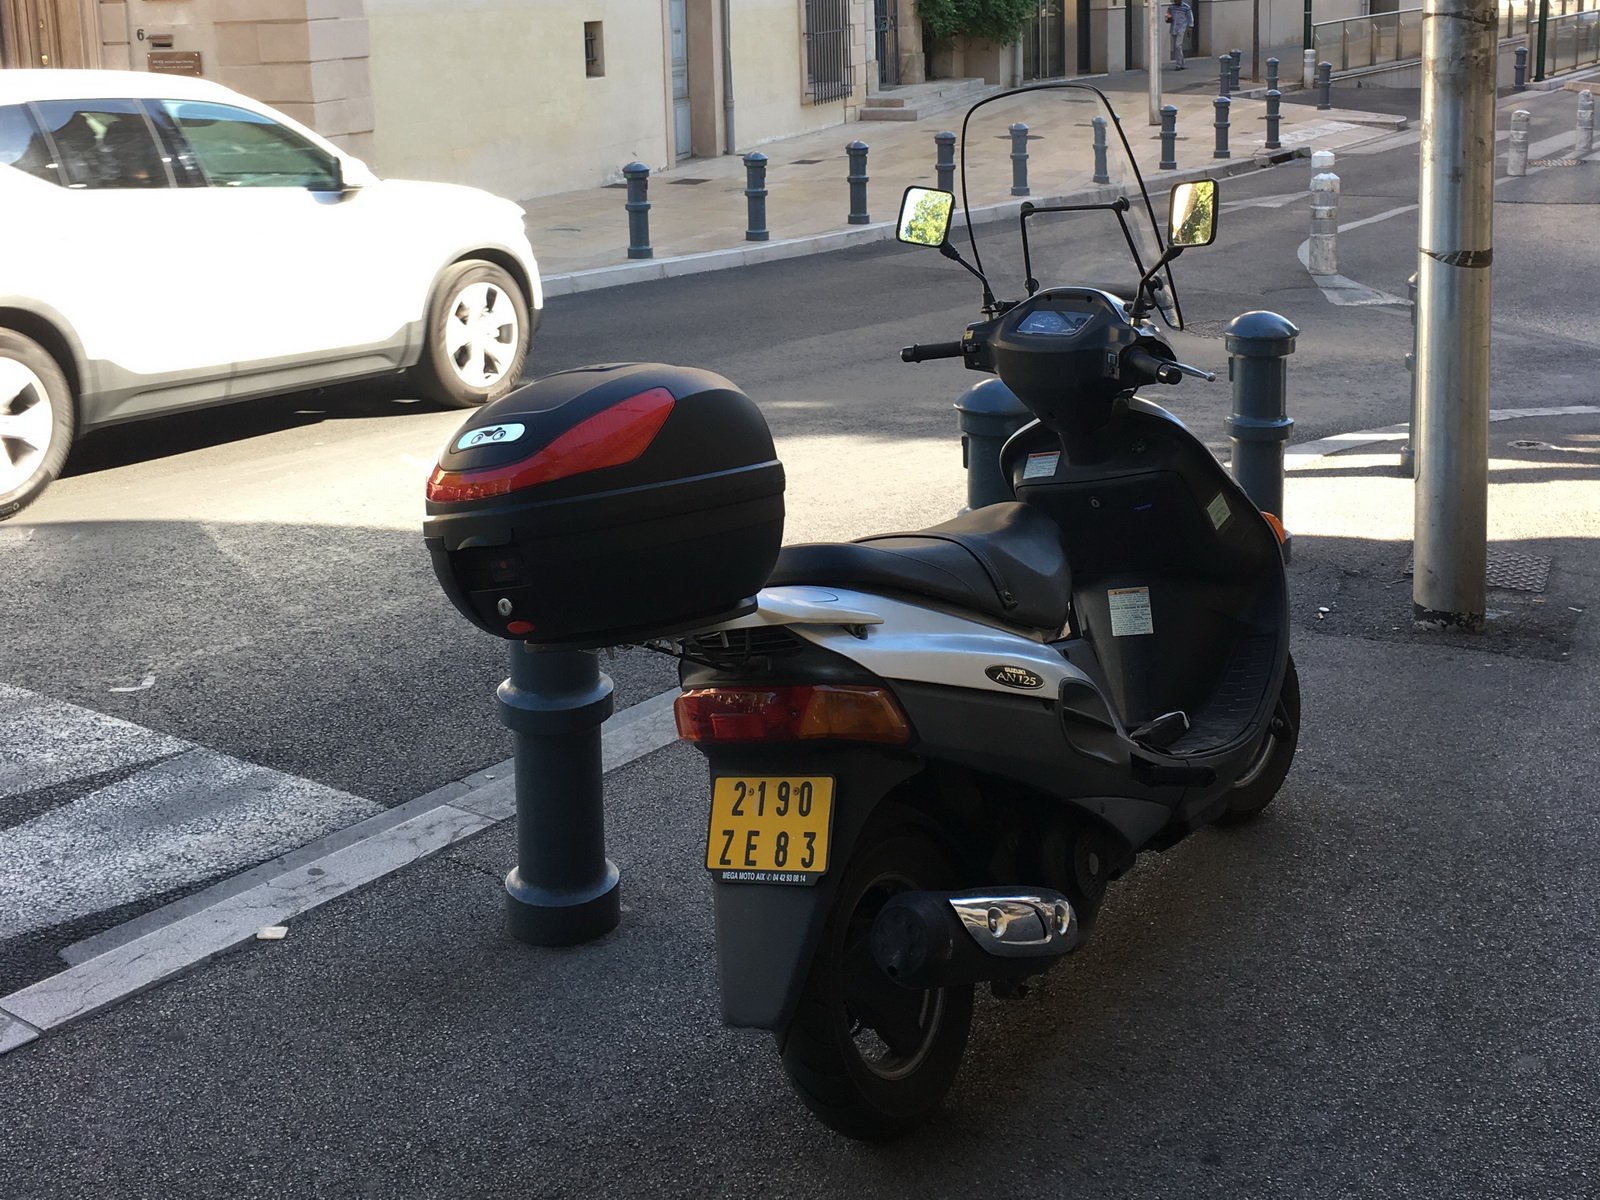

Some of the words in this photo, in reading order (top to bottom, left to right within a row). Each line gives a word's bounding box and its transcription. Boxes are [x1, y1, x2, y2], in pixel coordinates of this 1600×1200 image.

[136, 28, 145, 41] 6
[996, 672, 1016, 682] AN
[1019, 675, 1036, 685] 125
[731, 781, 813, 817] 2190
[719, 829, 760, 867] ZE
[774, 831, 817, 868] 83
[722, 871, 738, 879] MEGA
[738, 872, 755, 880] MOTO
[800, 874, 806, 882] 14
